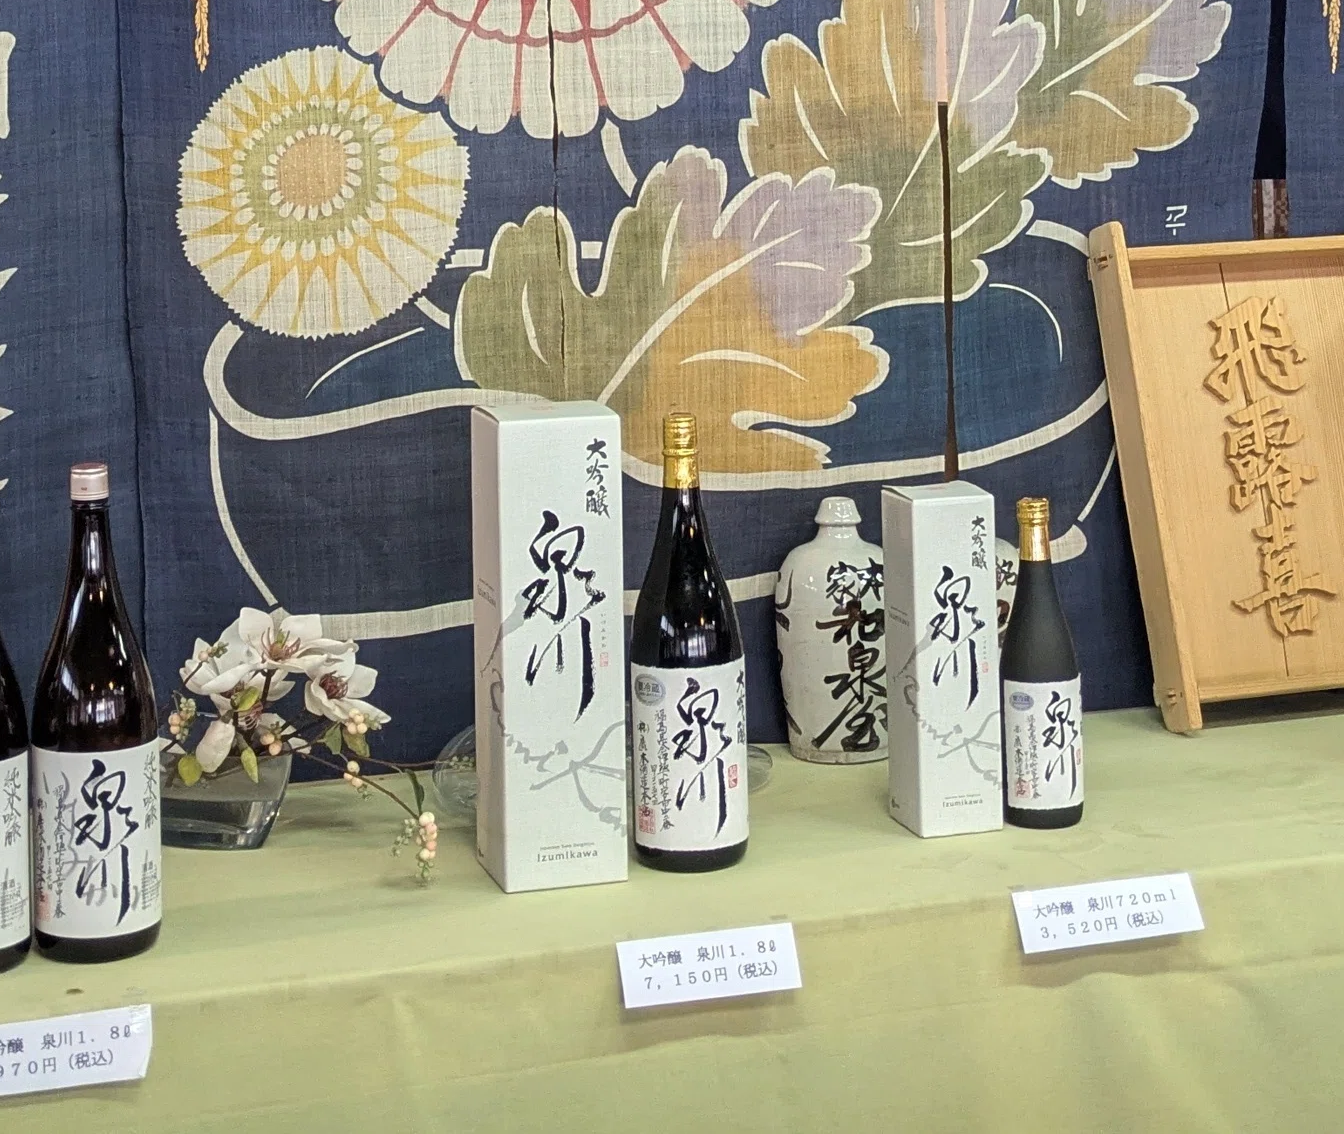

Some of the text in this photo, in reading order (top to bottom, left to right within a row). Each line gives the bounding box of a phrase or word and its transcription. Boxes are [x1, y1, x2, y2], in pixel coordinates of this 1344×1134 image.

[1203, 296, 1337, 639] 飛露喜
[522, 509, 607, 724] 泉川
[929, 565, 986, 711] 泉川
[671, 677, 733, 841] 泉川
[1042, 691, 1078, 801] 泉川
[74, 759, 139, 927] 泉川
[1033, 900, 1075, 919] 大吟醸
[638, 949, 683, 969] 大吟醸
